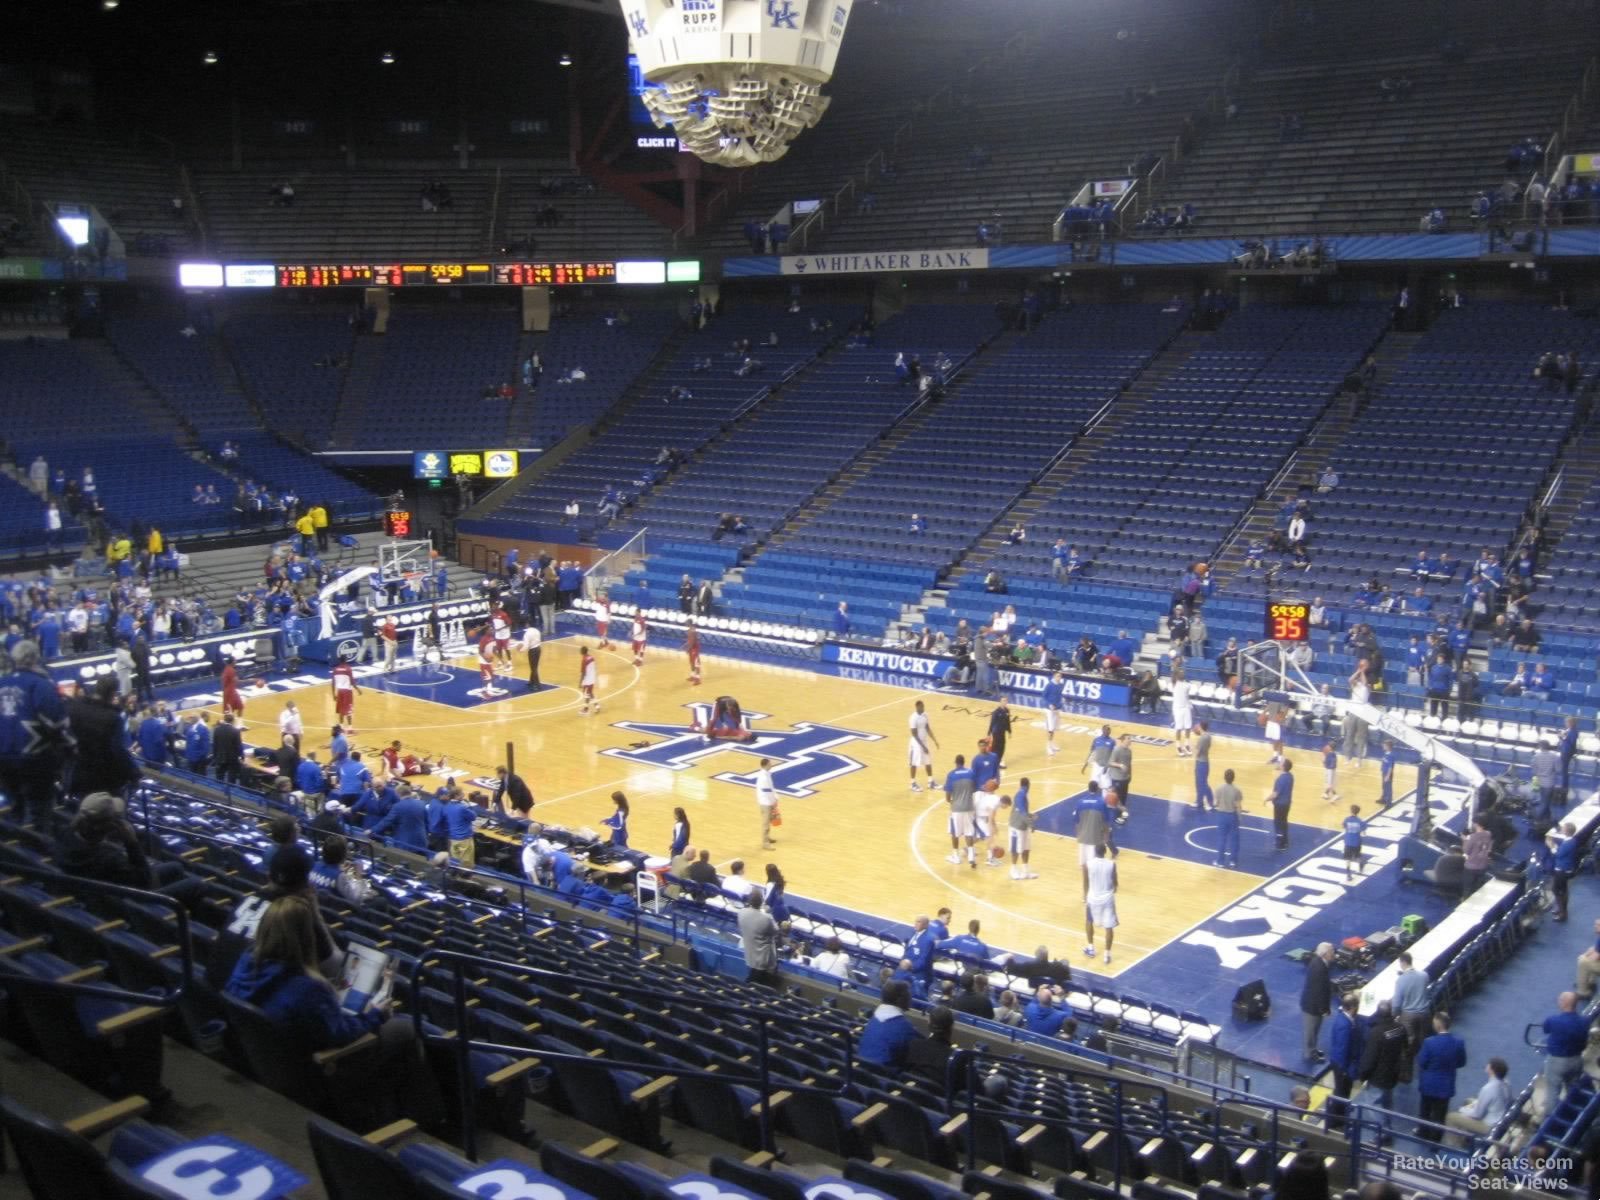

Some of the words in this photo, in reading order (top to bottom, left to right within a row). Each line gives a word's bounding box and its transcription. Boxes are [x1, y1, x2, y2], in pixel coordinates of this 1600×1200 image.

[683, 13, 717, 24] RUPP
[638, 138, 665, 147] CLICK
[666, 138, 676, 147] IT
[815, 254, 911, 271] WHITAKER
[920, 252, 971, 268] BANK
[1274, 617, 1301, 638] 35
[837, 647, 939, 675] KENTUCKY
[998, 669, 1102, 699] WILDATS
